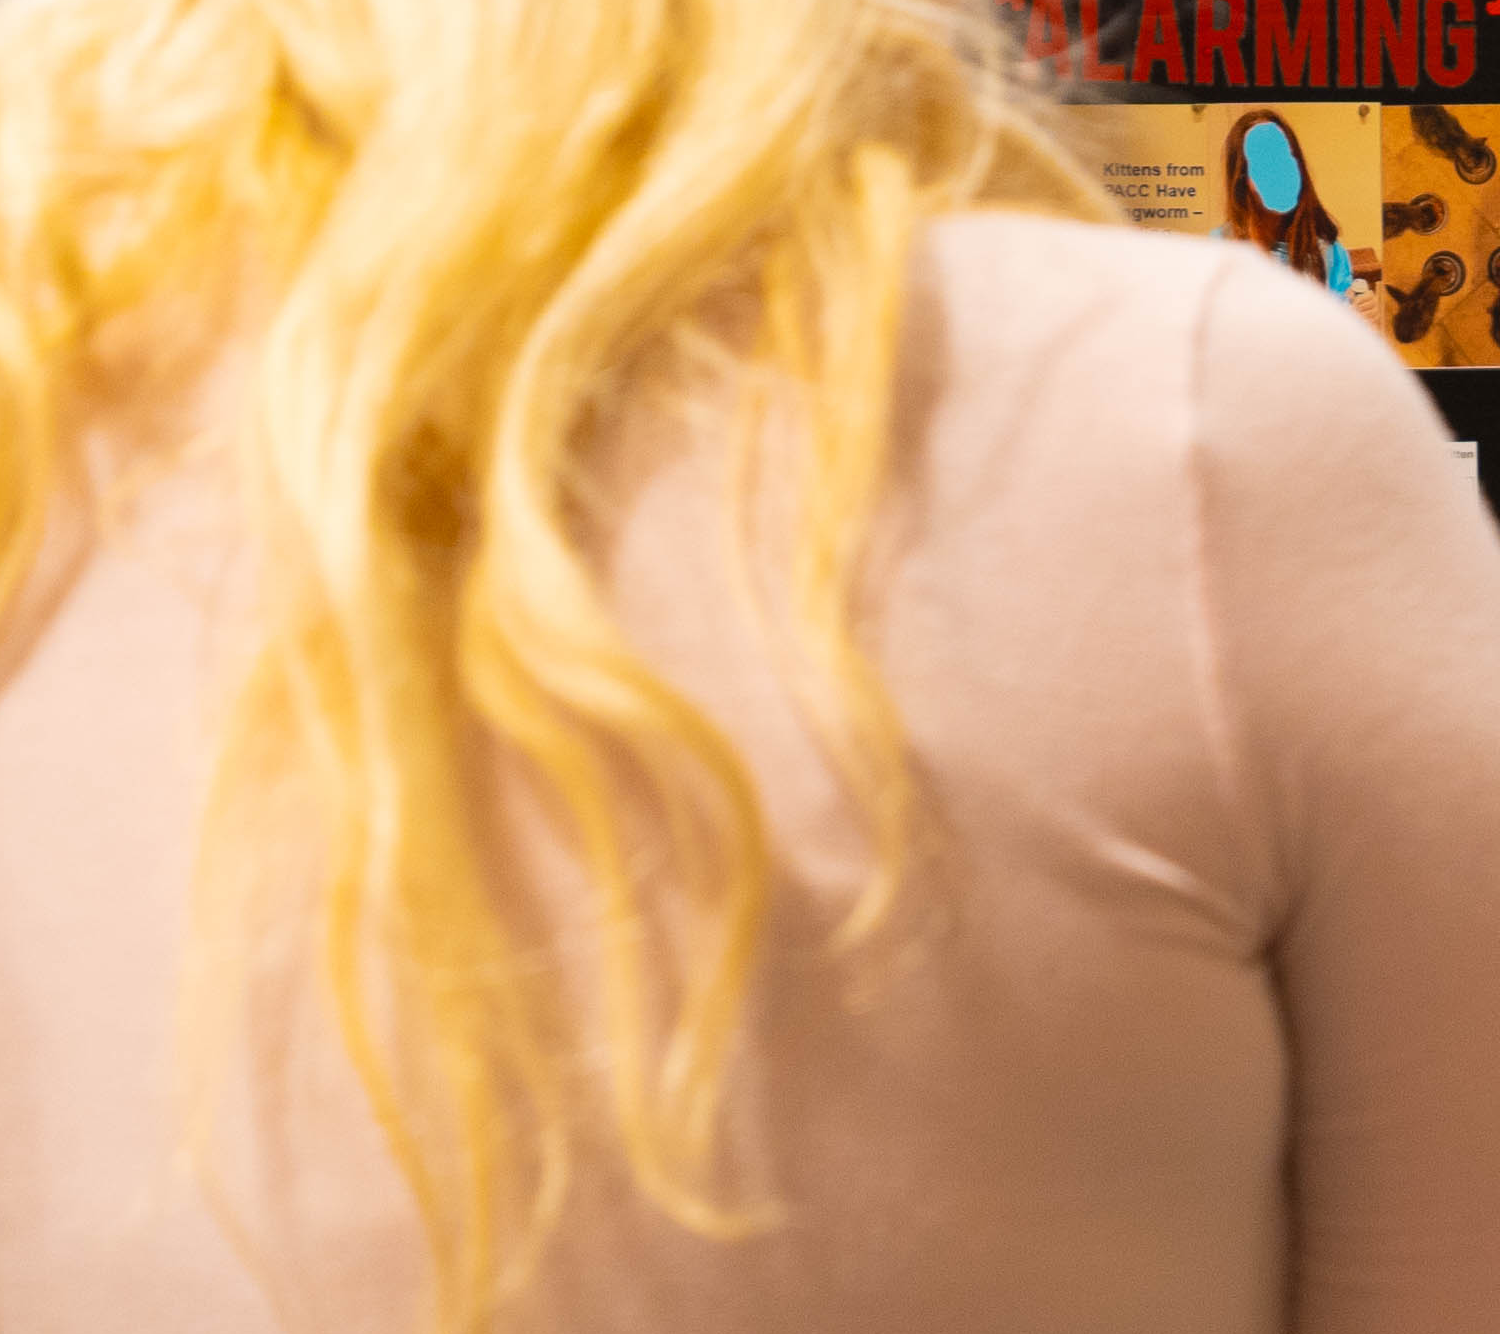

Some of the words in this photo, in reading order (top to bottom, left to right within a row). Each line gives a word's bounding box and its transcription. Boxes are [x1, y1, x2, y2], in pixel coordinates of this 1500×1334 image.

[1103, 162, 1161, 177] Kittens
[1166, 162, 1205, 176] from
[1156, 184, 1196, 197] Have
